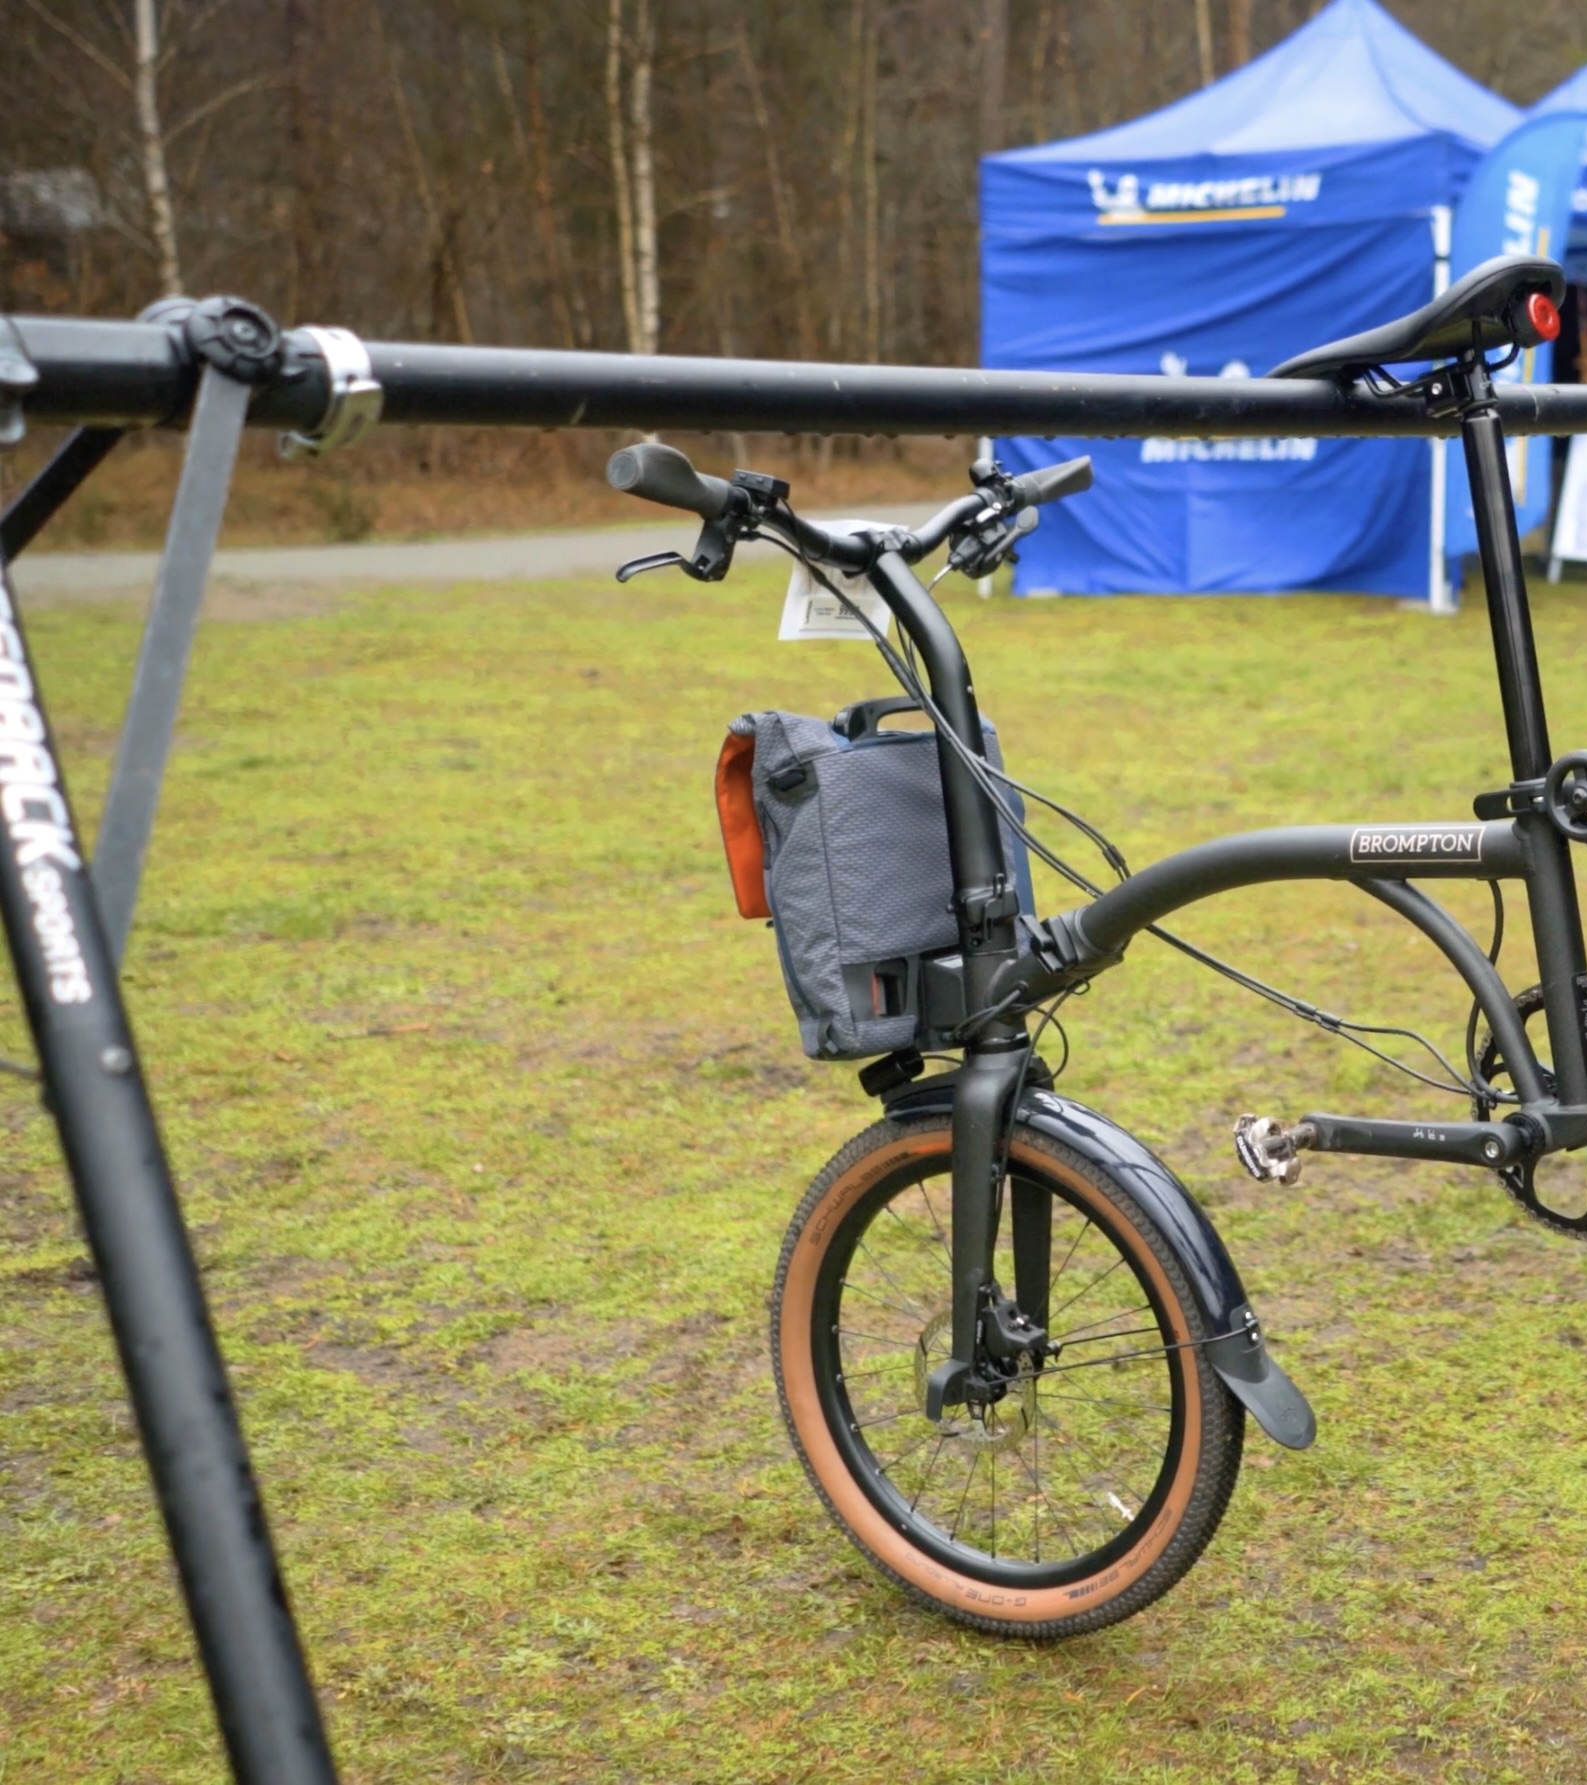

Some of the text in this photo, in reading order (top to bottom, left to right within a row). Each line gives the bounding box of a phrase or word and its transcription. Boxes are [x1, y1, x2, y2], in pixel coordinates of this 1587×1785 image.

[1146, 173, 1322, 209] MICHELIN
[1140, 436, 1317, 463] MICHELIN
[1358, 833, 1474, 853] BROMPTON
[23, 867, 92, 1003] SPORTS
[809, 1165, 882, 1245] SCHWALBE
